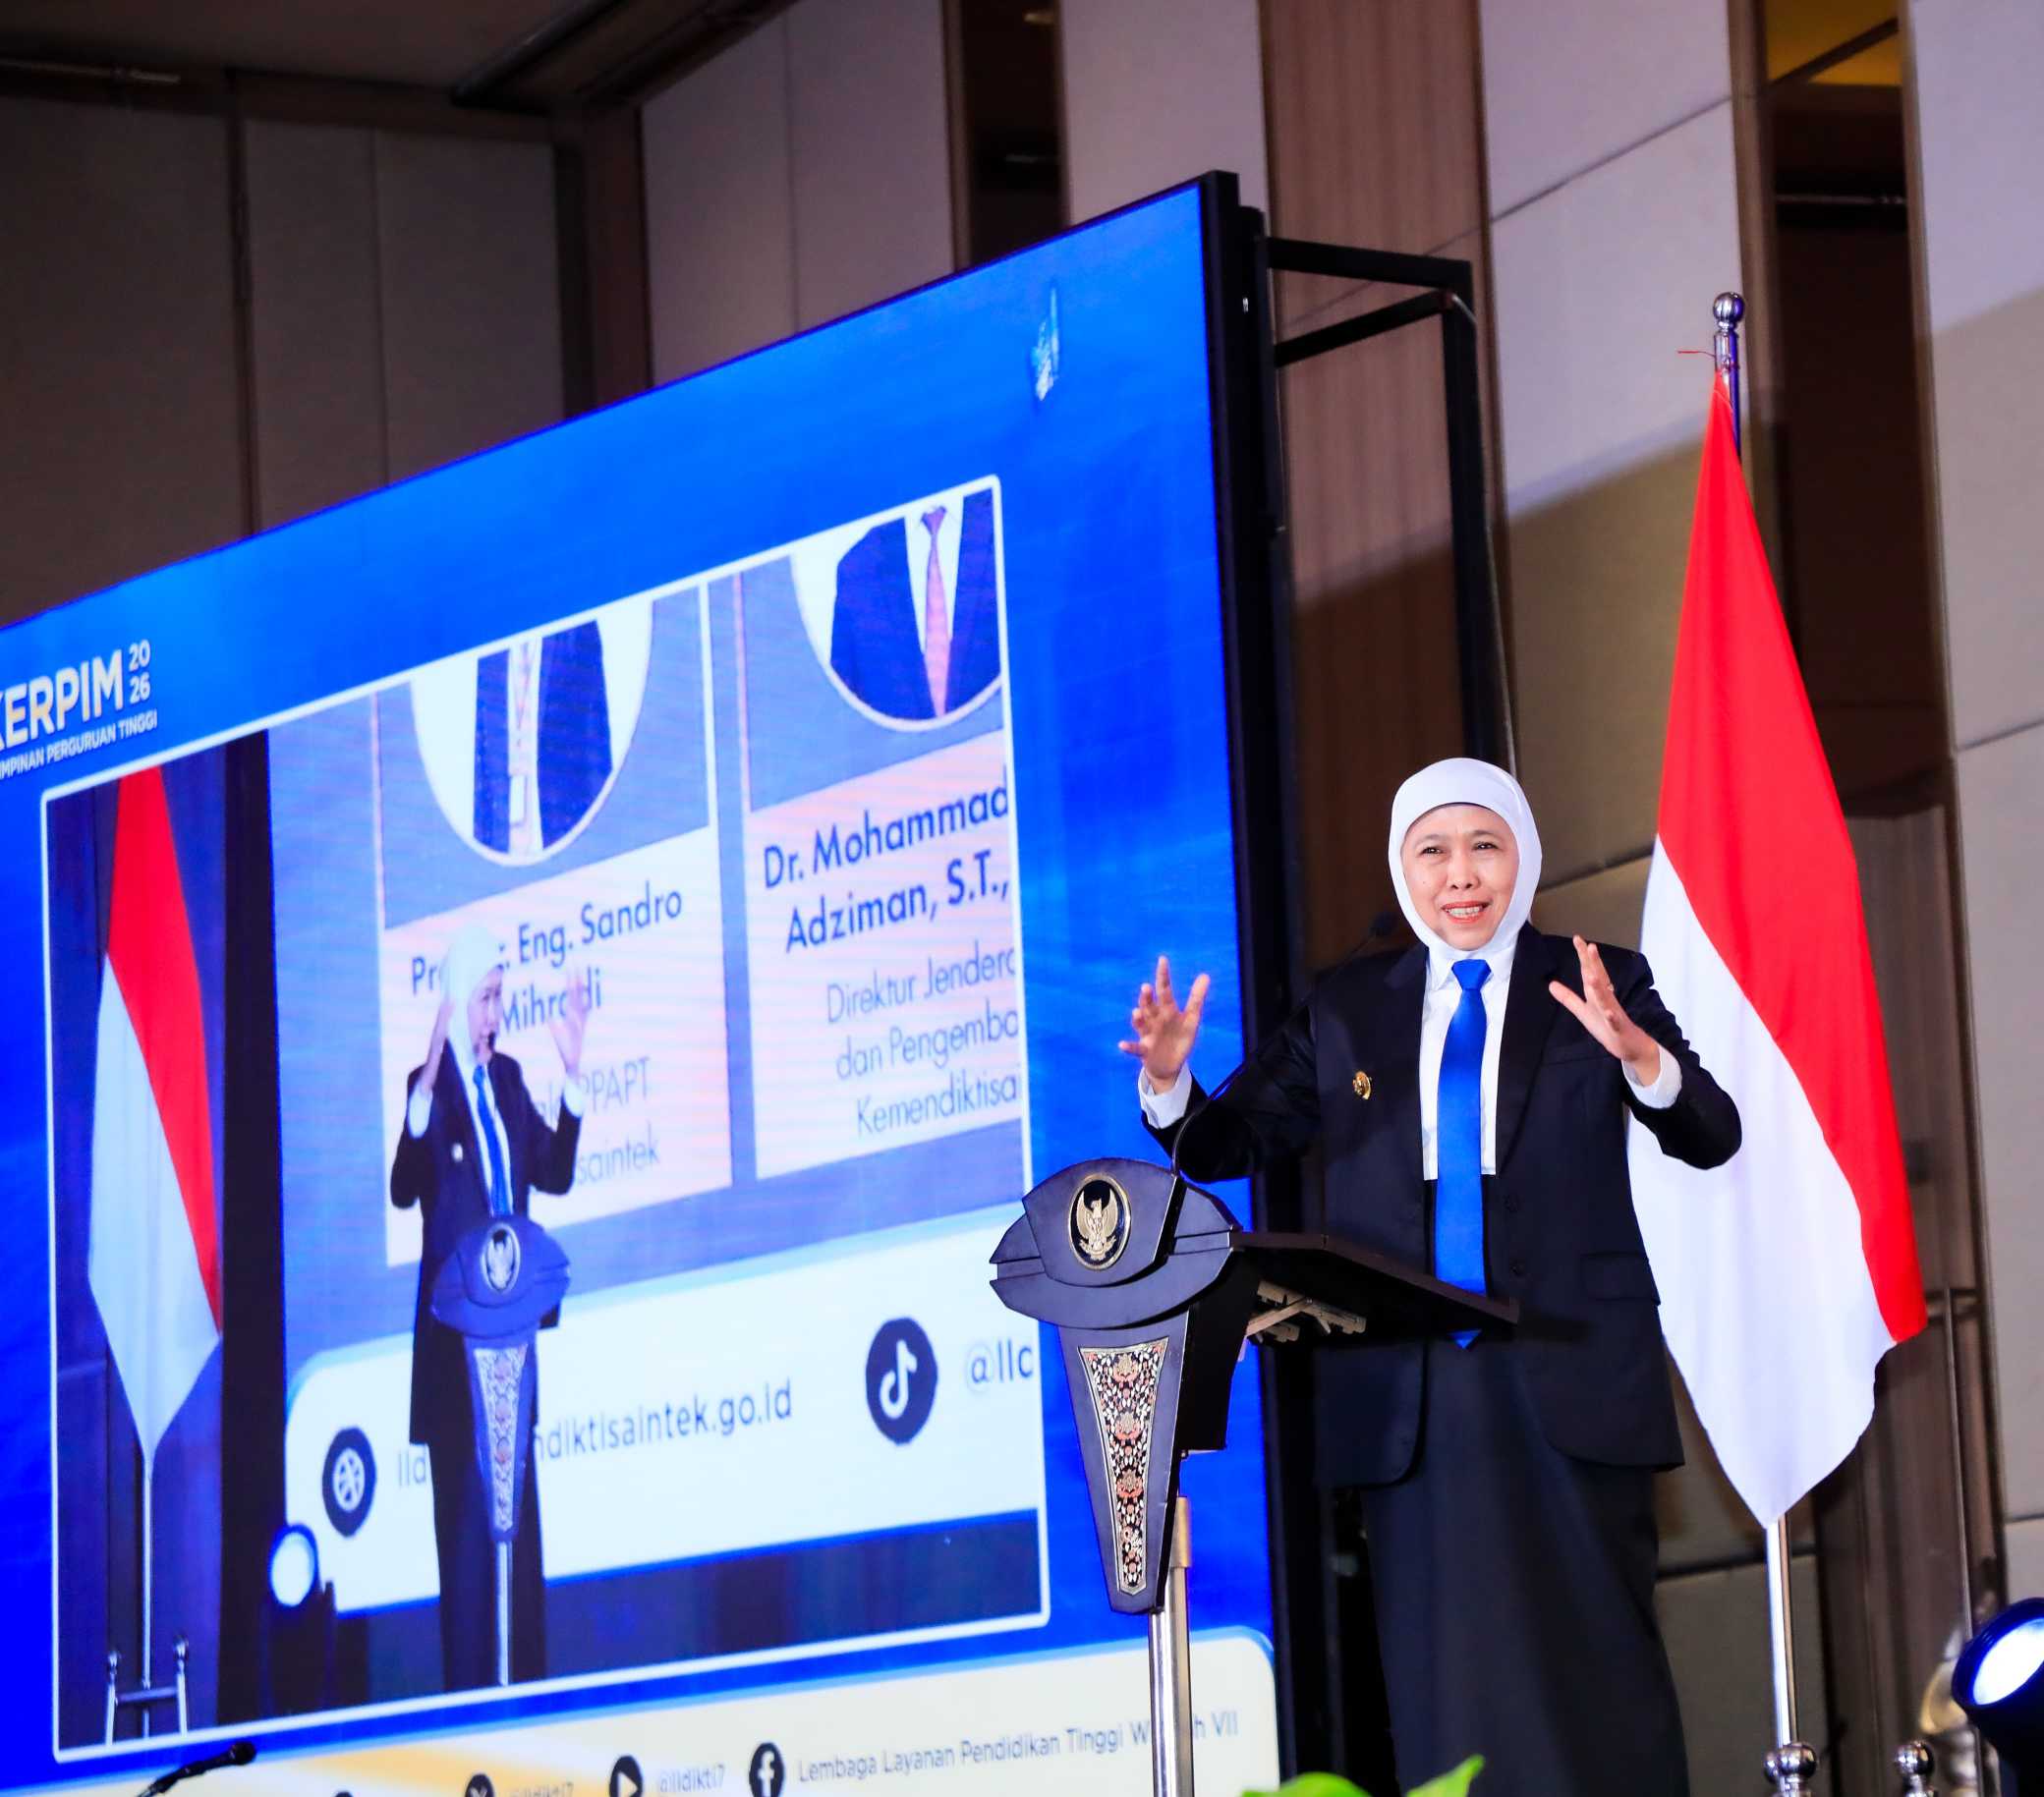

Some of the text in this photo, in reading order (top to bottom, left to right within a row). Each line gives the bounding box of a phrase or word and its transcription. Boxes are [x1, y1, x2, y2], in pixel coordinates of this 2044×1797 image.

[129, 640, 151, 672] 20
[0, 649, 124, 753] ERPIM
[129, 672, 151, 704] 26
[46, 723, 116, 764] PERGURUAN
[118, 709, 158, 739] TINGGI
[764, 844, 804, 888] Dr.
[518, 923, 574, 968] Eng.
[581, 880, 682, 944] Sandro
[786, 849, 1008, 953] Adziman, S.T.,
[827, 970, 916, 1024] Direktur
[836, 1035, 882, 1081] dan
[578, 1119, 660, 1185] saintek
[798, 1754, 878, 1782] Lembaga
[882, 1746, 955, 1776] Layanan
[960, 1732, 1061, 1766] Pendidikan
[1066, 1721, 1123, 1754] Tinggi
[1211, 1710, 1239, 1737] VII
